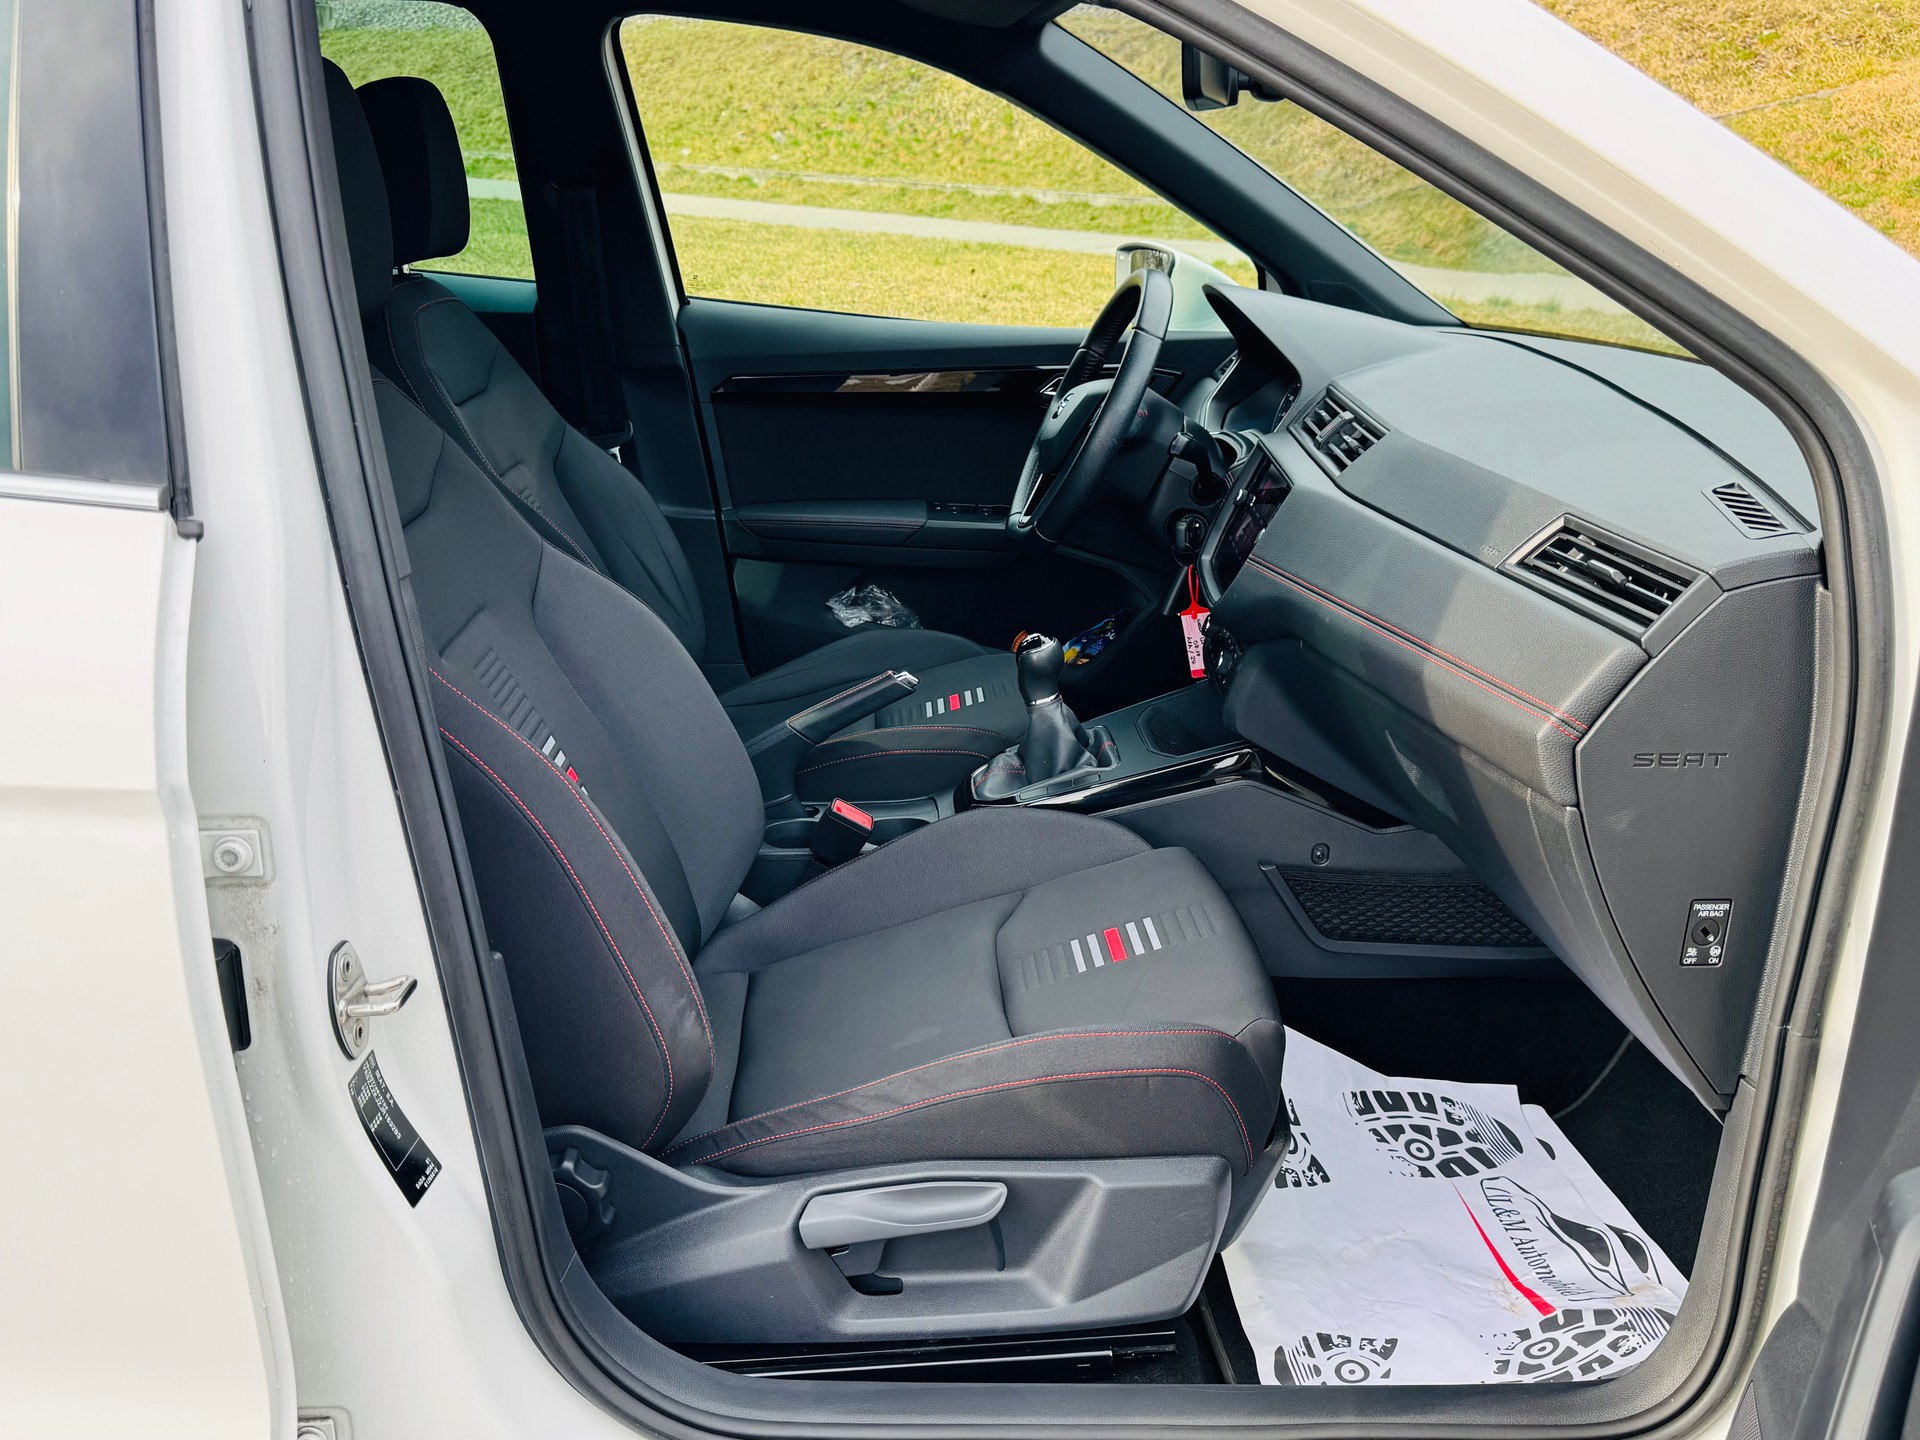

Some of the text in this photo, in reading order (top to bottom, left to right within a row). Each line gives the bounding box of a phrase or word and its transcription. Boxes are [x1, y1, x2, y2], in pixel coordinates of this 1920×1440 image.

[1632, 752, 1729, 768] SEAT
[1693, 903, 1730, 911] PASSENGER
[1683, 957, 1698, 965] OFF
